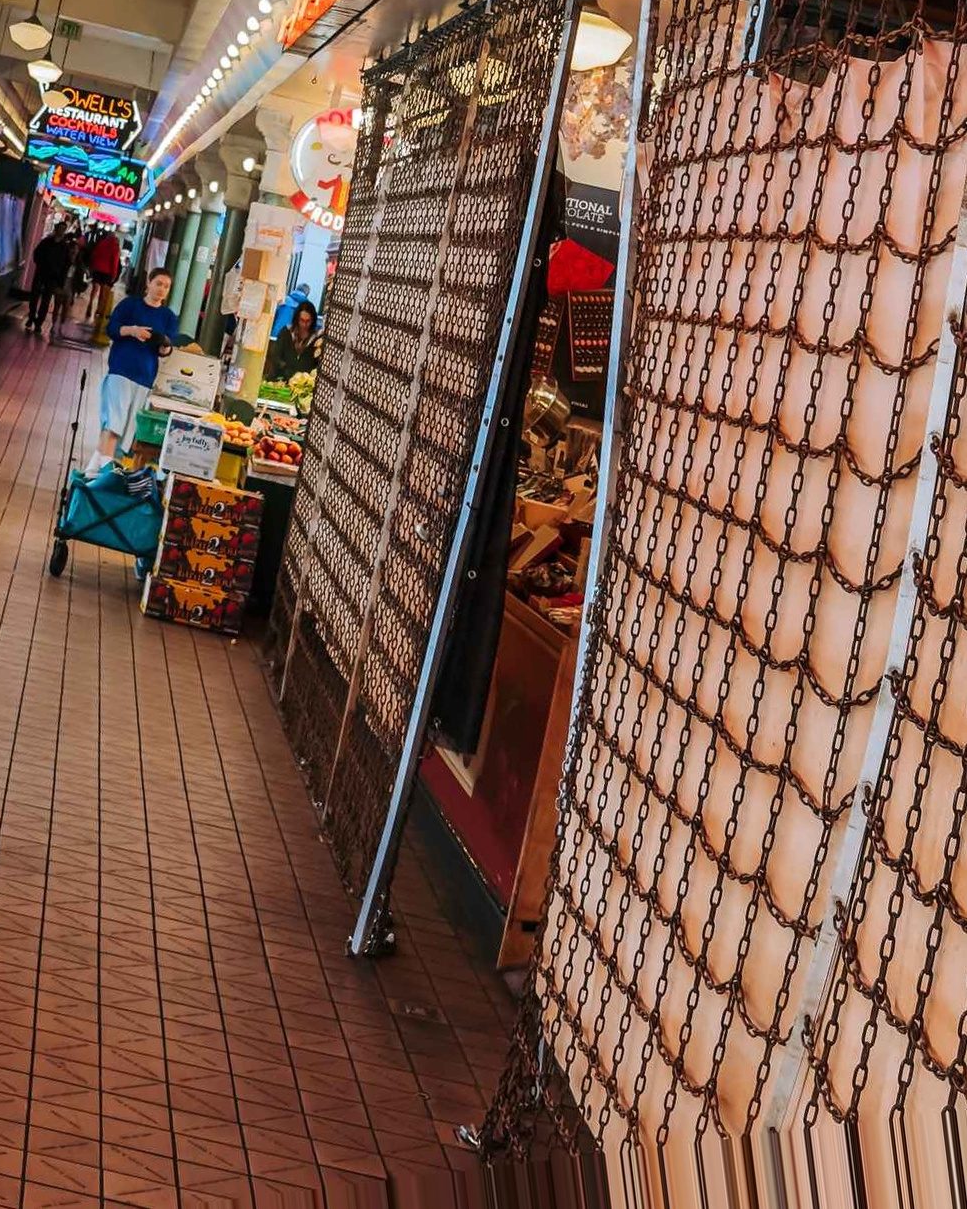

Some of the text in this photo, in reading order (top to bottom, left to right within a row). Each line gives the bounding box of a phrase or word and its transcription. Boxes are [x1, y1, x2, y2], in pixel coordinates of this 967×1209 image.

[61, 87, 132, 120] OWELL'S
[45, 123, 120, 148] WATER VIEW
[47, 114, 118, 140] COCKTAILS
[64, 171, 136, 203] SEAFOOD
[301, 199, 345, 232] PROD
[566, 197, 613, 217] TIONAL
[566, 206, 606, 224] OLATE
